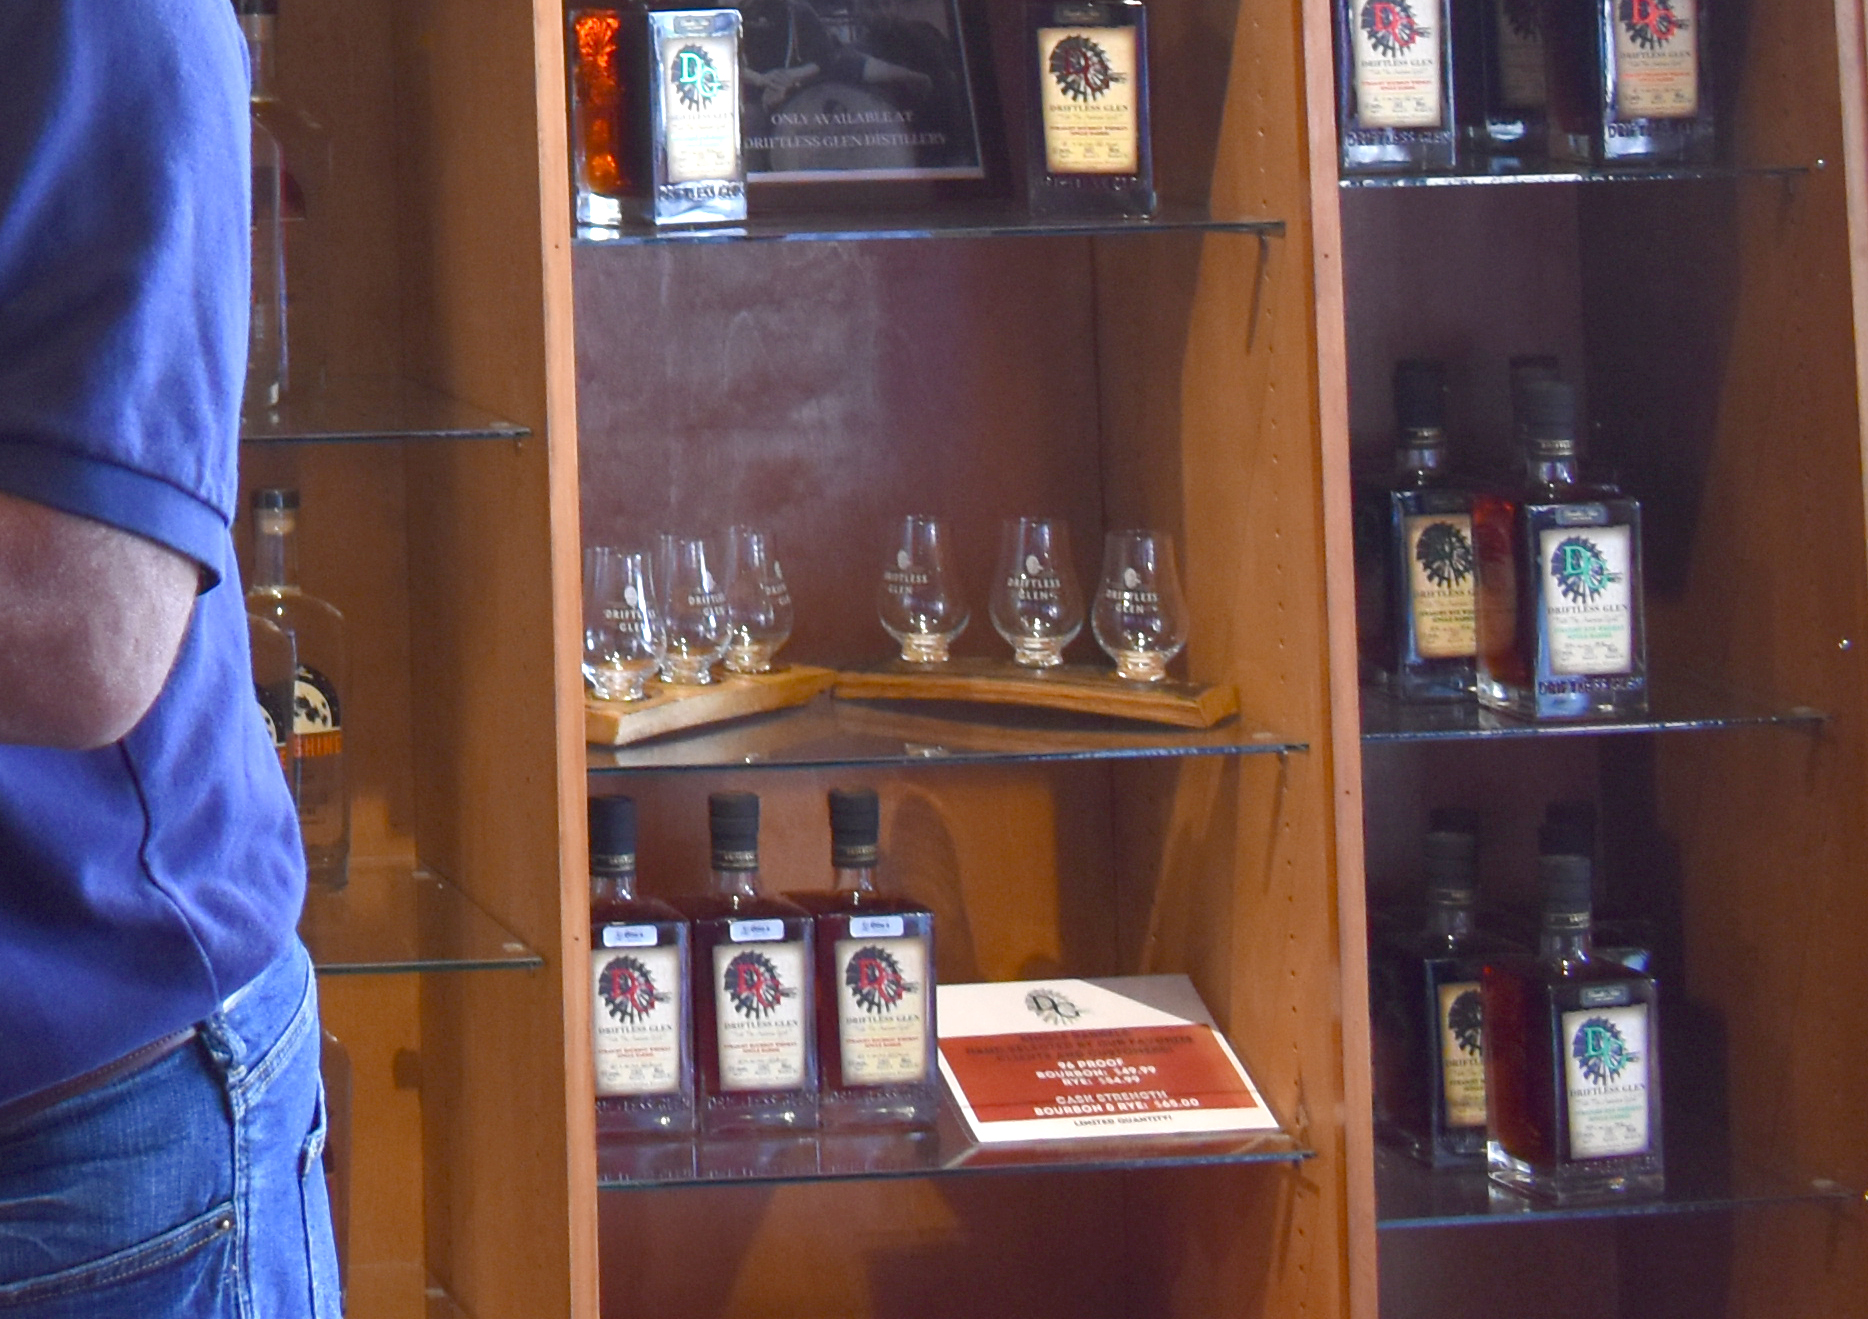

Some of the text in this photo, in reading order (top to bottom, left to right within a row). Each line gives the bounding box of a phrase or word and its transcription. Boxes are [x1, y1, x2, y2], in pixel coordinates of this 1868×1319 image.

[770, 113, 809, 126] ONLY
[813, 111, 896, 125] AVAILABLE
[743, 132, 946, 150] DRIFTLESS GLEN DISTILLERY
[1007, 576, 1062, 590] DRIFTLESS
[1105, 589, 1160, 603] DRIFTLESS
[1547, 603, 1629, 614] DRIFTLESS GLEN
[1076, 1057, 1125, 1069] PROOF
[1035, 1065, 1157, 1080] BOURBON: $49.99
[1061, 1077, 1094, 1087] RYE:
[1055, 1089, 1169, 1105] CASK STRENGTH
[1033, 1103, 1104, 1117] BOURBON
[1116, 1100, 1149, 1111] RYE:
[1116, 1114, 1173, 1124] QUANTITY!
